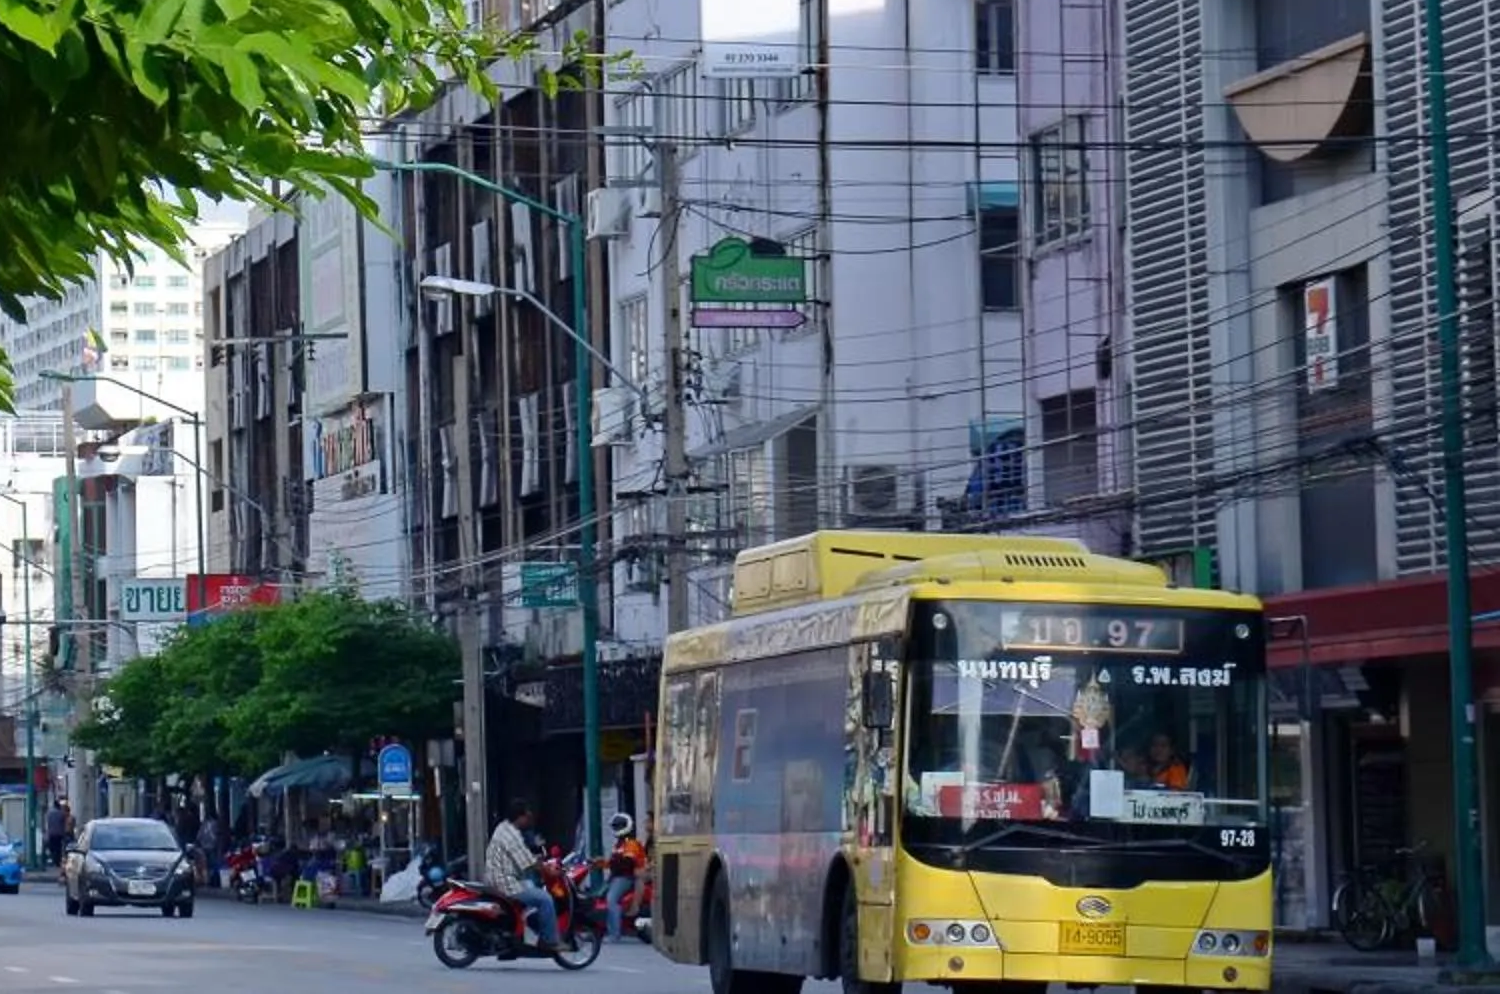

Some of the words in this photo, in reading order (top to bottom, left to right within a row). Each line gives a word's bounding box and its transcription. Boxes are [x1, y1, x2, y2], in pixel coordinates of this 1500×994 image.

[957, 655, 1052, 689] นนทบุรี
[1219, 829, 1256, 847] 97-28
